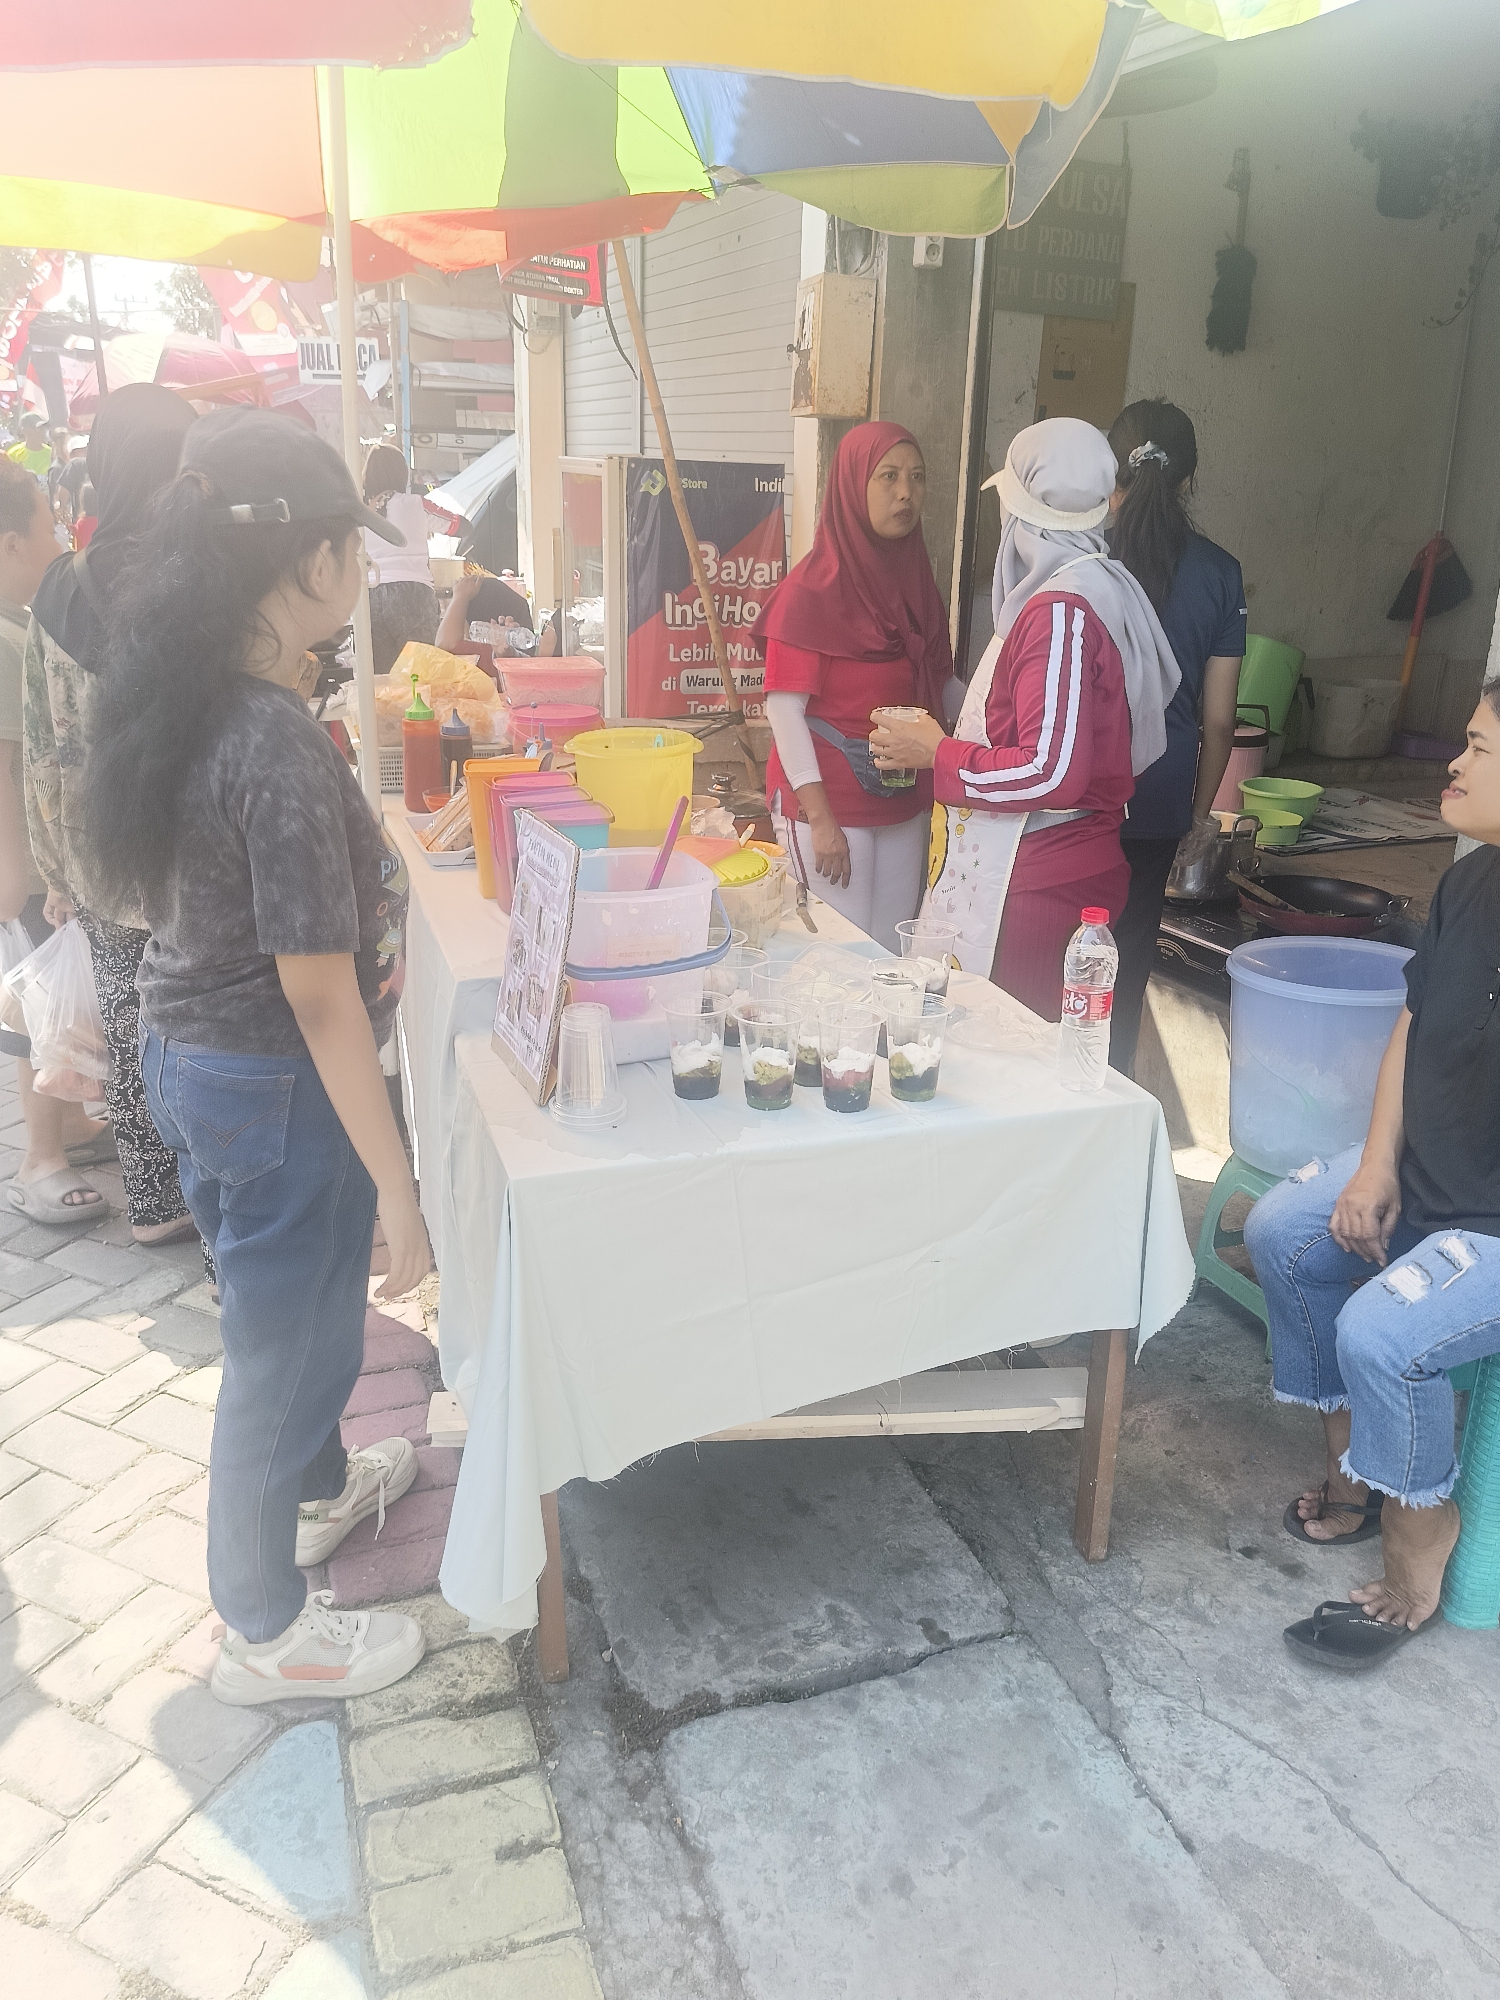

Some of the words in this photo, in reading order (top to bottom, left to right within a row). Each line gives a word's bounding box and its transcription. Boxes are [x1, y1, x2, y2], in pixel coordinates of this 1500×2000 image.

[1032, 269, 1117, 306] LISTRIK
[300, 342, 335, 372] JUAL
[337, 343, 379, 372] CA
[661, 675, 677, 691] di
[298, 1513, 319, 1521] NWO
